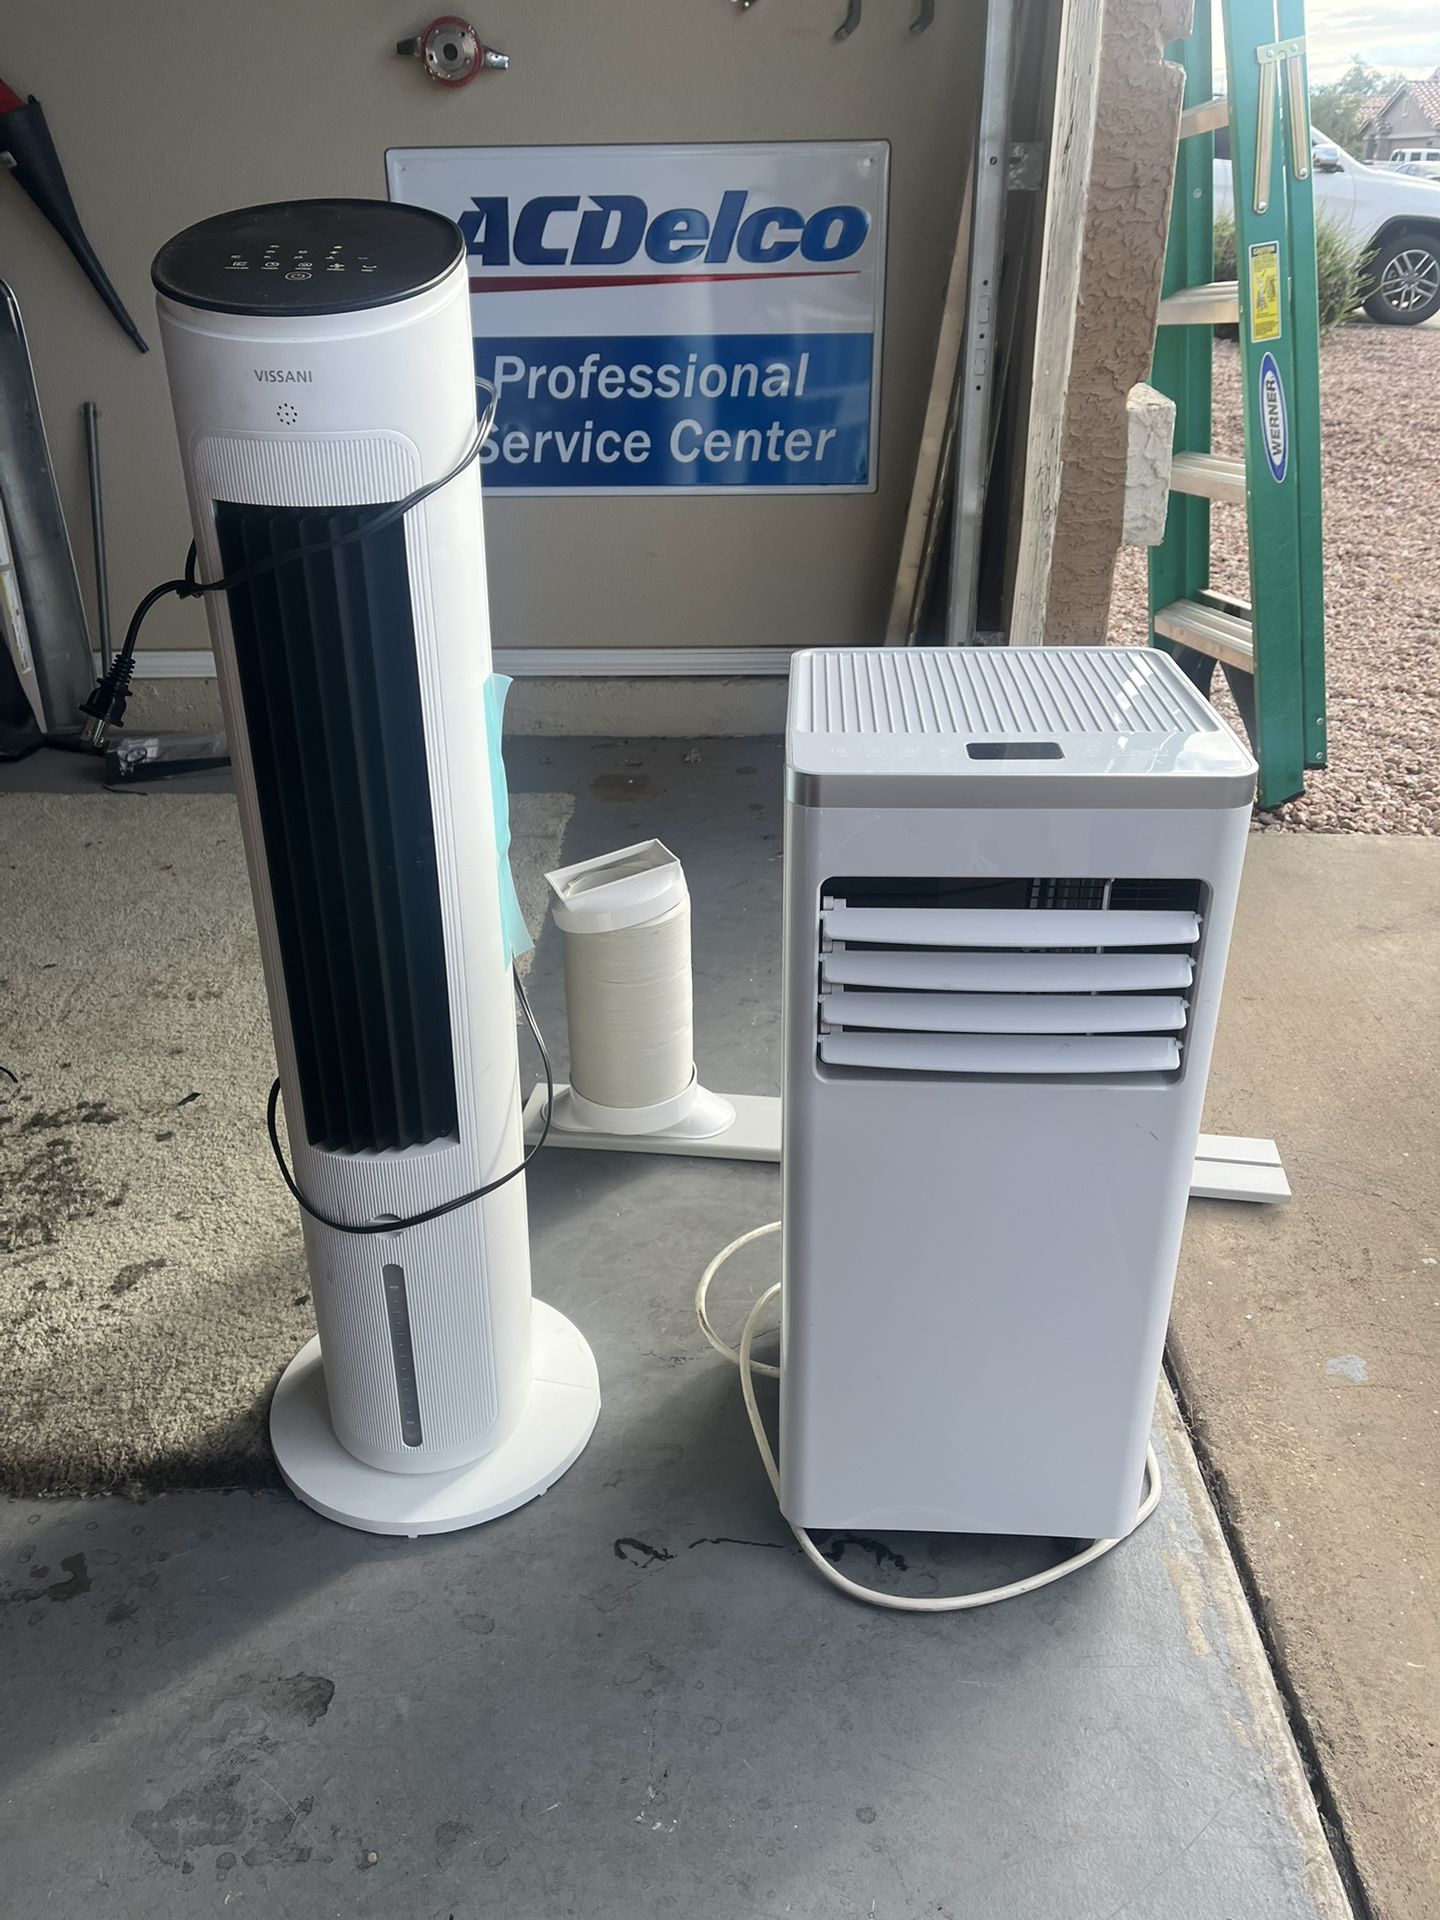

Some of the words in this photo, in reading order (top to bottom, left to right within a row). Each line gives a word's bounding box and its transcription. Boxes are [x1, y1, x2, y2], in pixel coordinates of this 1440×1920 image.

[456, 190, 871, 266] ACDelco
[253, 369, 313, 383] VISSANI
[494, 353, 809, 400] Professional
[1266, 378, 1283, 456] WERNER
[670, 419, 837, 463] Center
